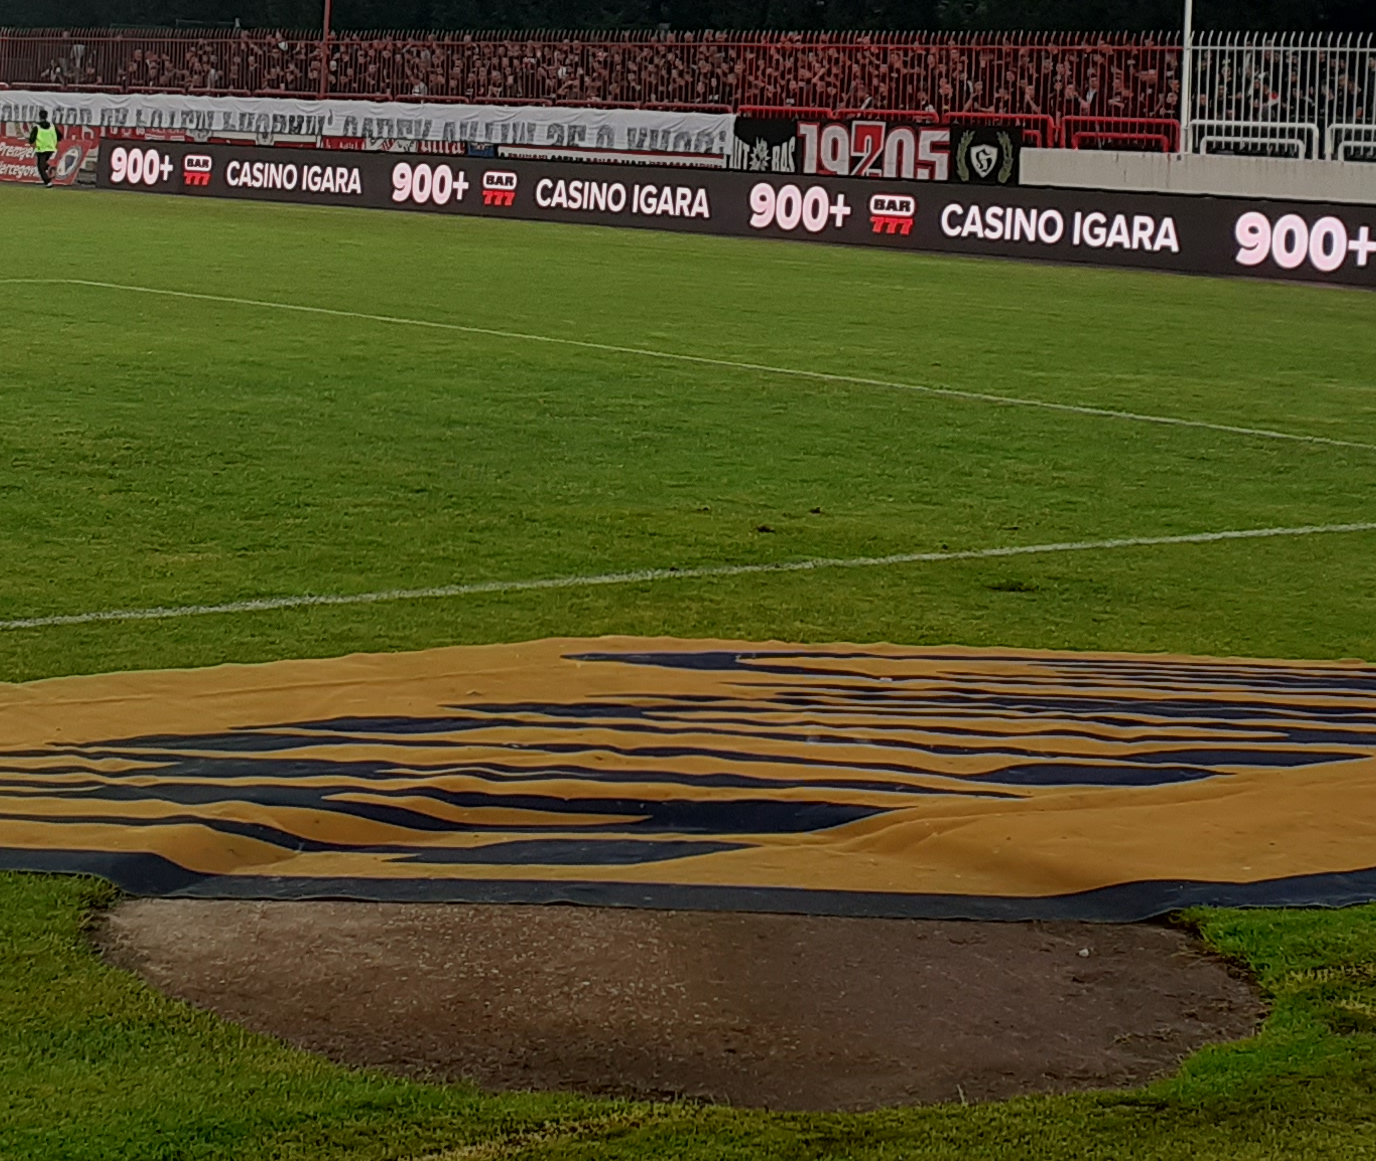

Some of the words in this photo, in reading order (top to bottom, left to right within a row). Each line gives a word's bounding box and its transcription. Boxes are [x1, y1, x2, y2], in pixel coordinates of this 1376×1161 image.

[111, 147, 174, 185] 900+
[184, 172, 212, 186] 777
[226, 160, 298, 190] CASINO
[301, 165, 362, 194] IGARA
[486, 175, 514, 187] BAR
[392, 162, 469, 205] 900+
[482, 190, 516, 206] 777
[536, 178, 627, 212] CASINO
[632, 184, 710, 218] IGARA
[749, 182, 851, 232] 900+
[873, 199, 911, 212] BAR
[870, 216, 914, 235] 777
[941, 203, 1064, 244] CASINO
[1072, 211, 1179, 252] IGARA
